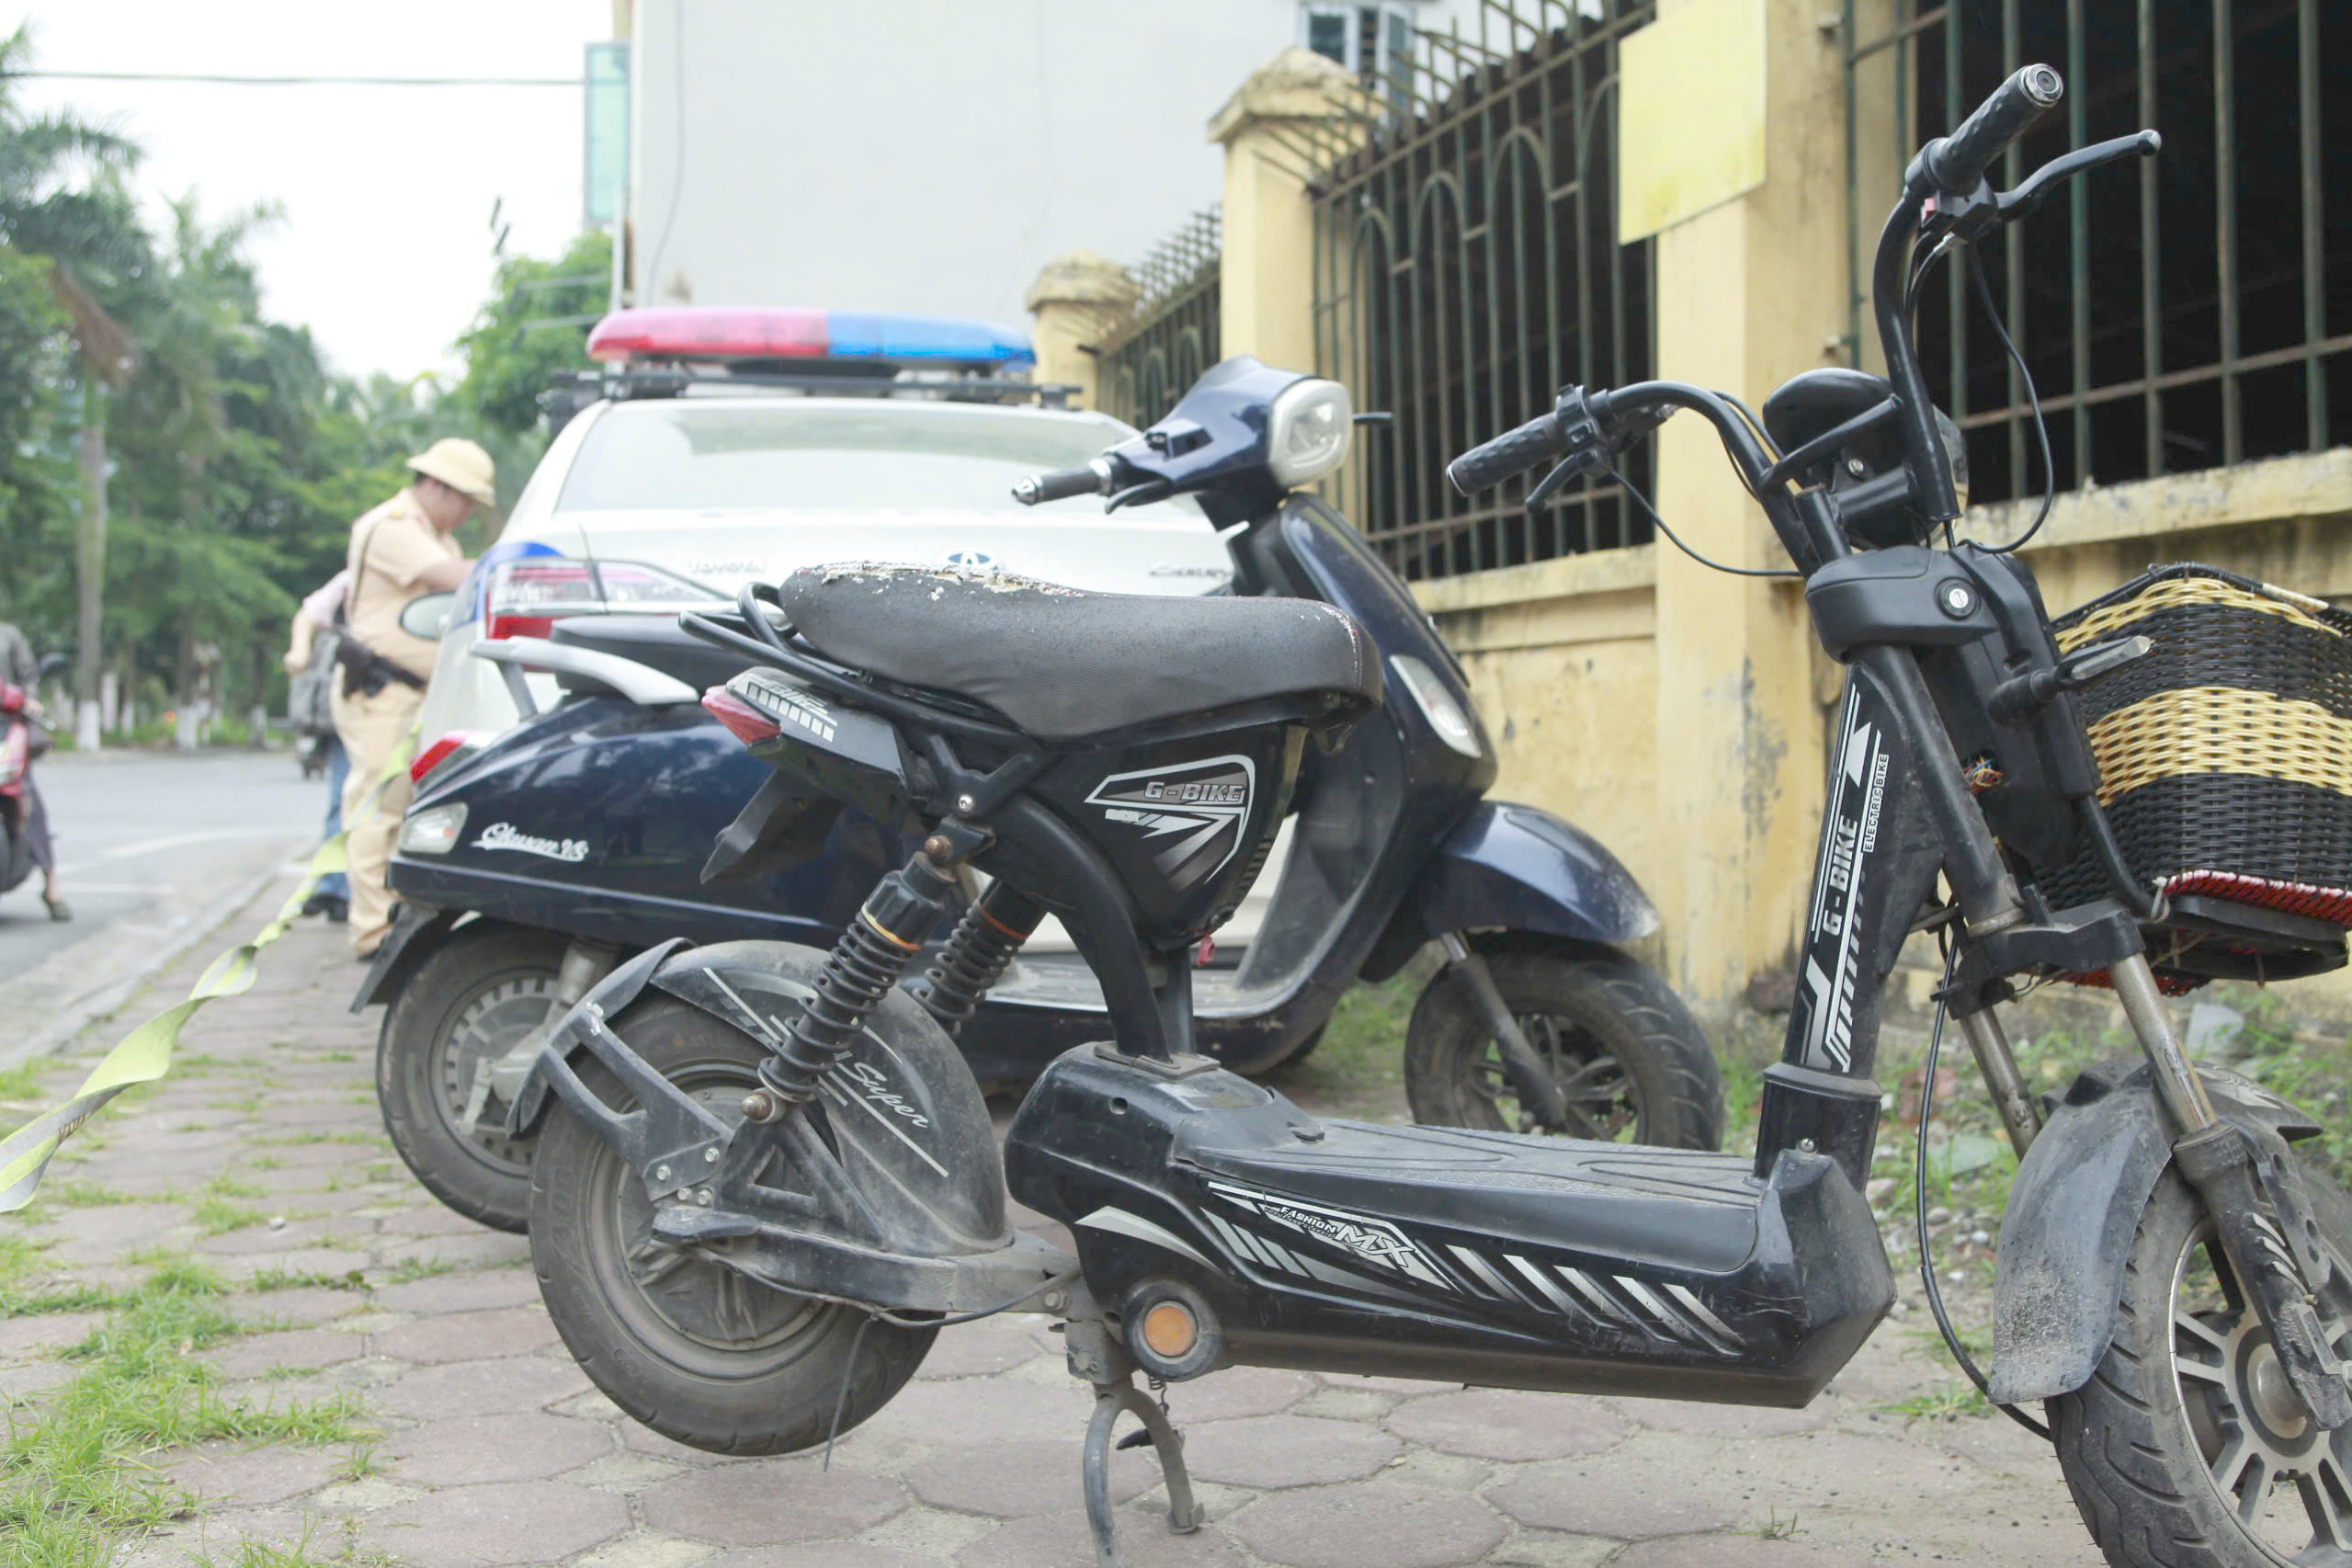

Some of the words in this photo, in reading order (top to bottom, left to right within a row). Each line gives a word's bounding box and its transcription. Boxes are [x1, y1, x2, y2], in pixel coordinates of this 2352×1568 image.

[1862, 787, 1883, 853] ELECTRIC
[1873, 753, 1889, 788] BIKE
[836, 1062, 929, 1129] Super
[1279, 1206, 1337, 1233] FASHION
[1334, 1222, 1416, 1267] MX
